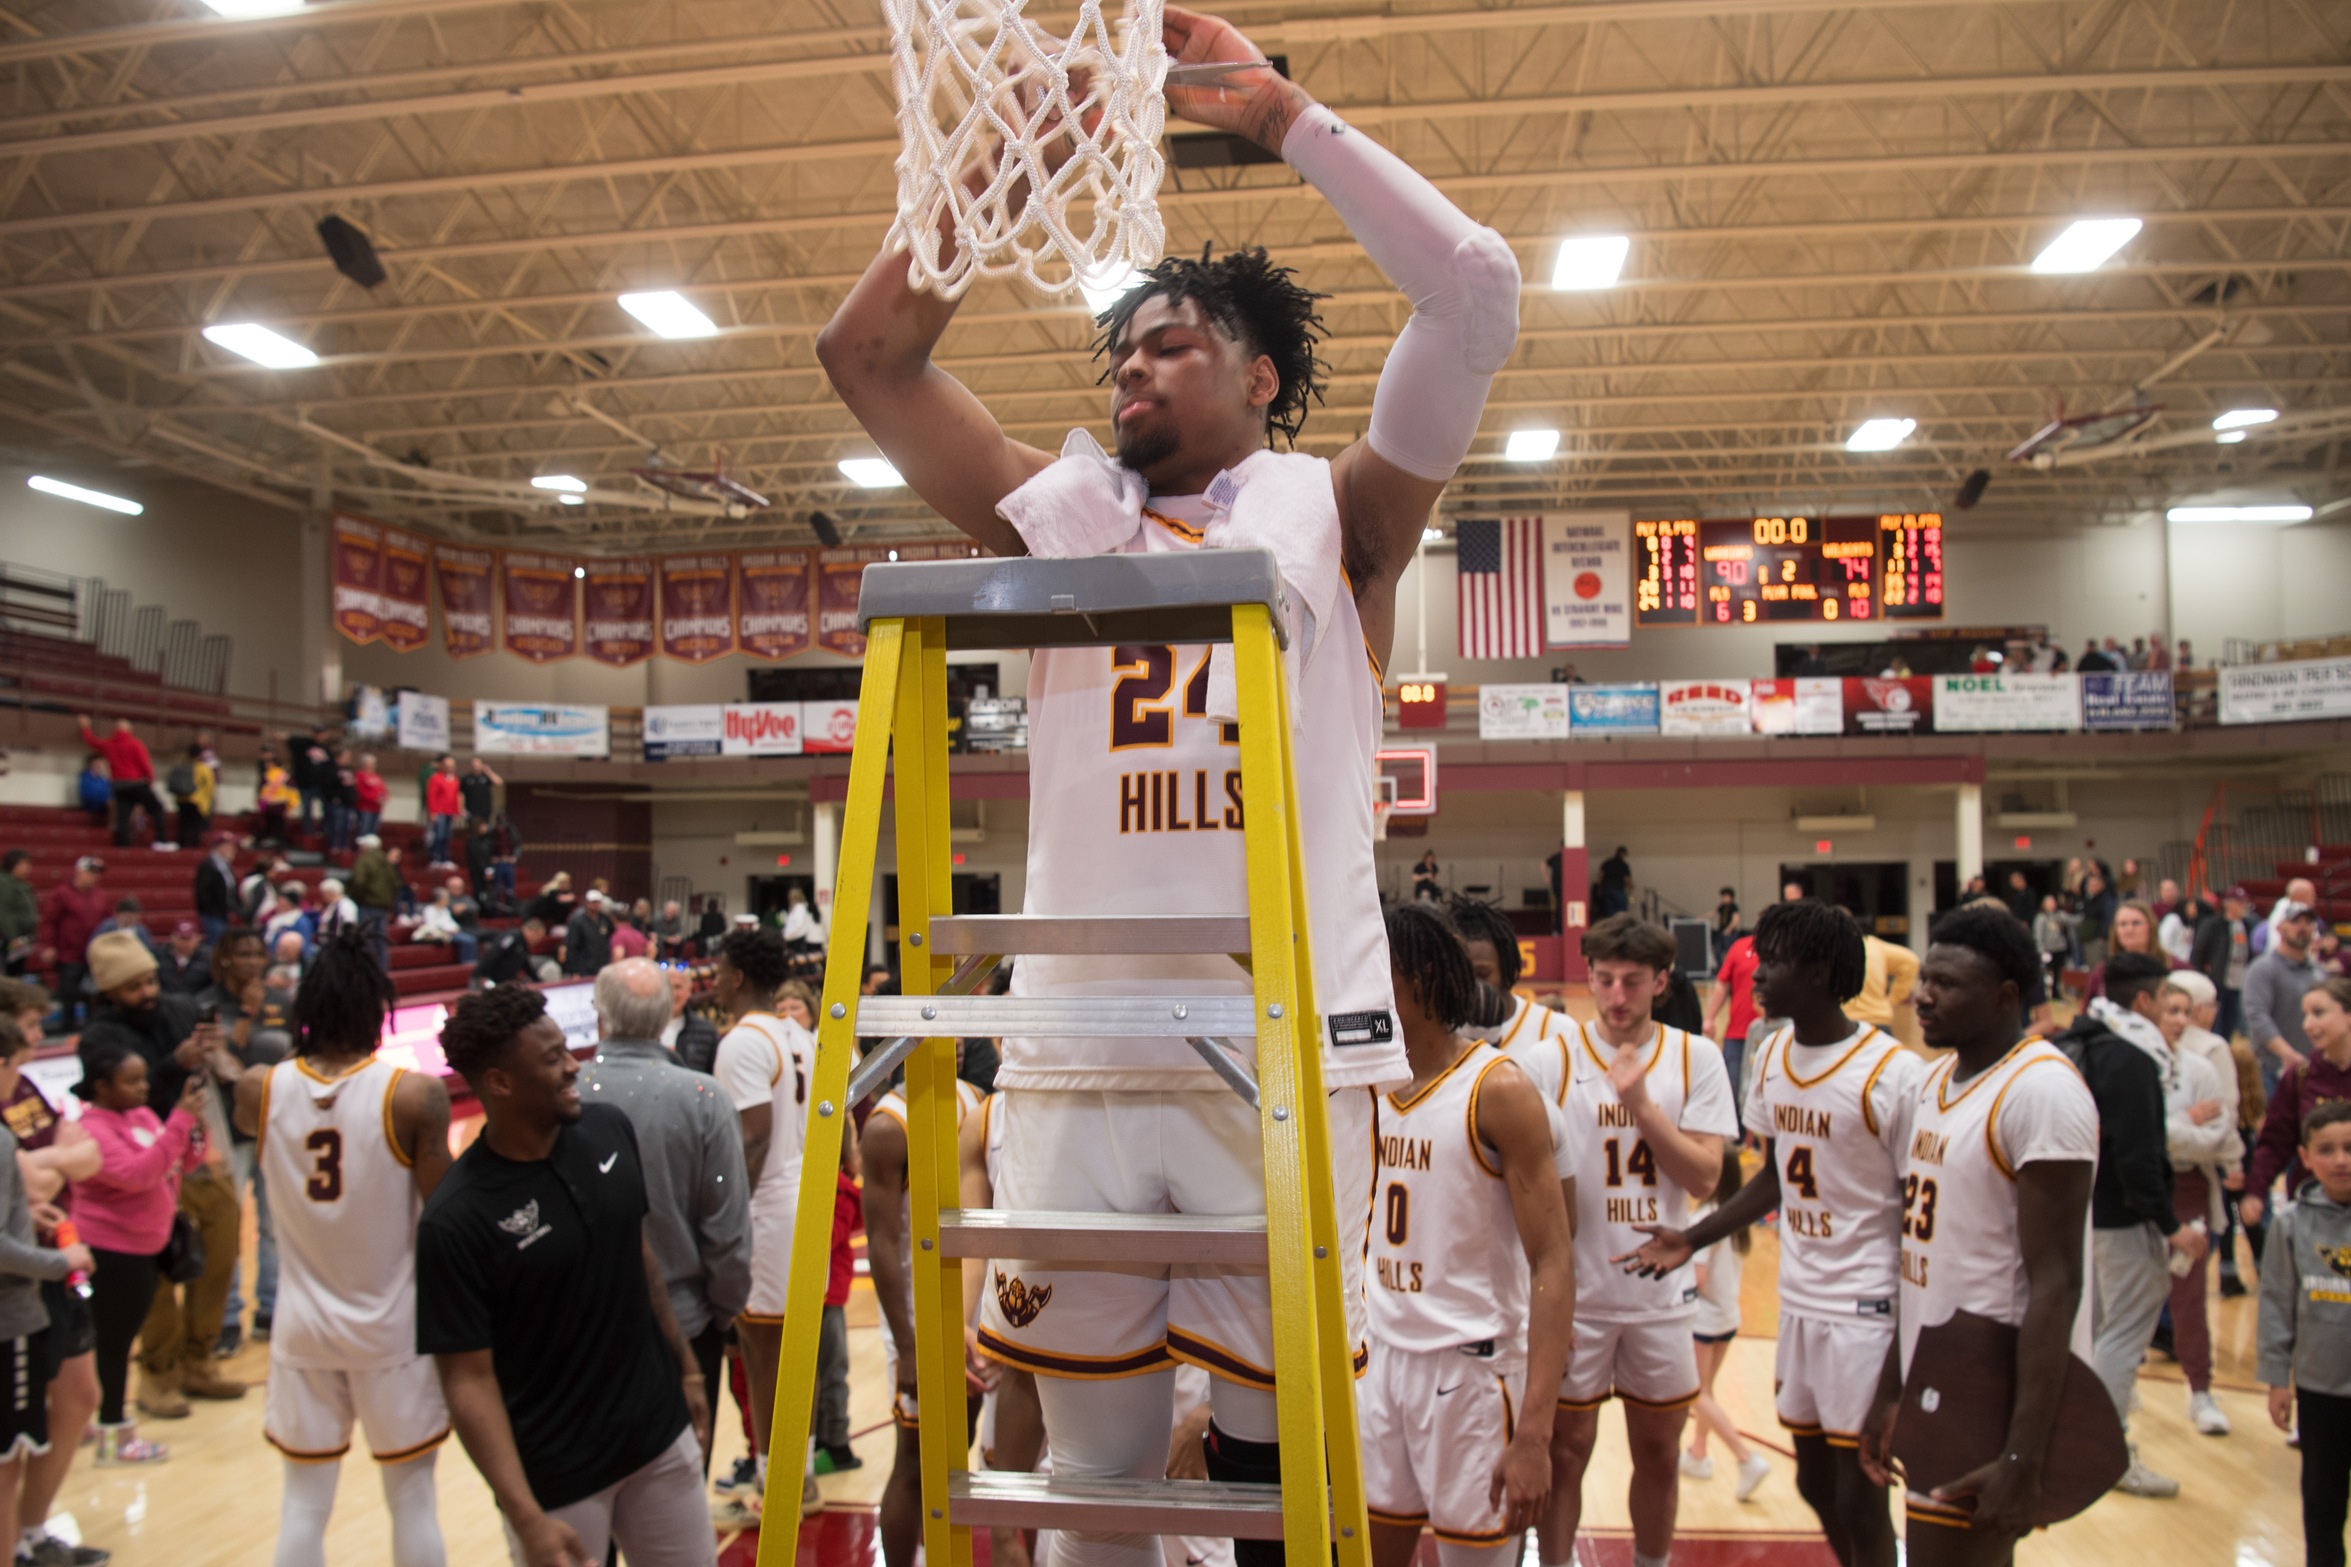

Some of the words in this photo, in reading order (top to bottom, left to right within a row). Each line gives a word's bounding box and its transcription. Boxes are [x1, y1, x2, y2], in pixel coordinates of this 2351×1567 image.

[1754, 518, 1808, 544] 00.0
[1716, 560, 1748, 585] 90
[1782, 560, 1797, 582] 2
[1838, 558, 1868, 580] 74
[1716, 601, 1730, 622] 6
[1743, 600, 1757, 622] 3
[1823, 598, 1838, 620] 0
[1850, 598, 1870, 619] 10
[1946, 679, 2006, 693] NOEL
[1120, 768, 1245, 835] HILLS
[1374, 1018, 1390, 1034] XL
[1774, 1104, 1831, 1139] INDIAN
[306, 1128, 343, 1202] 3
[1378, 1135, 1432, 1172] NDIAN
[1603, 1137, 1657, 1188] 14
[1785, 1144, 1820, 1201] 4
[1386, 1179, 1410, 1248] 0
[1606, 1197, 1658, 1223] HILLS
[1785, 1207, 1832, 1239] HILLS
[1902, 1171, 1940, 1245] 23
[1377, 1256, 1424, 1293] HILLS
